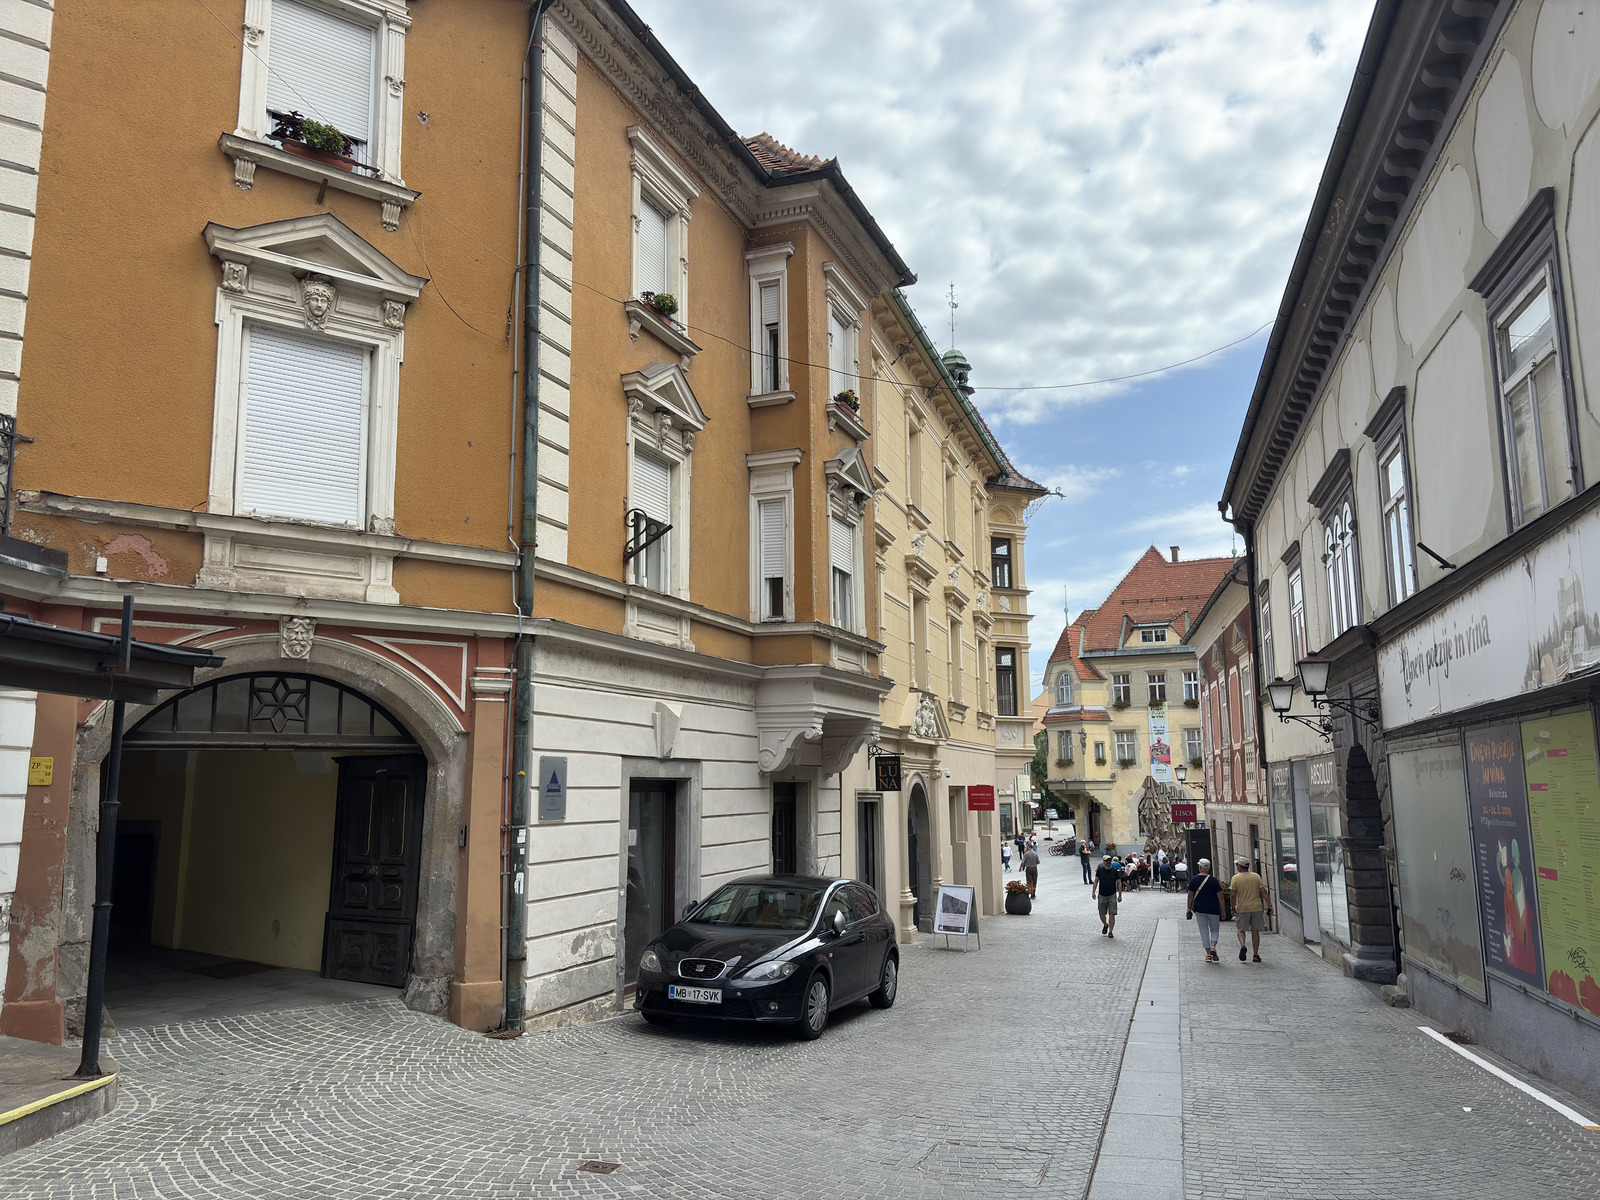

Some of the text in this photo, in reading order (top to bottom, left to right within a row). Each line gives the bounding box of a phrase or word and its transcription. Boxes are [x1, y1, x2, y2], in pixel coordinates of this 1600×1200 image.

[1466, 614, 1492, 657] vina
[878, 765, 898, 777] LU
[1311, 761, 1333, 785] ABSOLUT
[879, 777, 898, 789] NA
[675, 988, 719, 1001] MB 17-SVK
